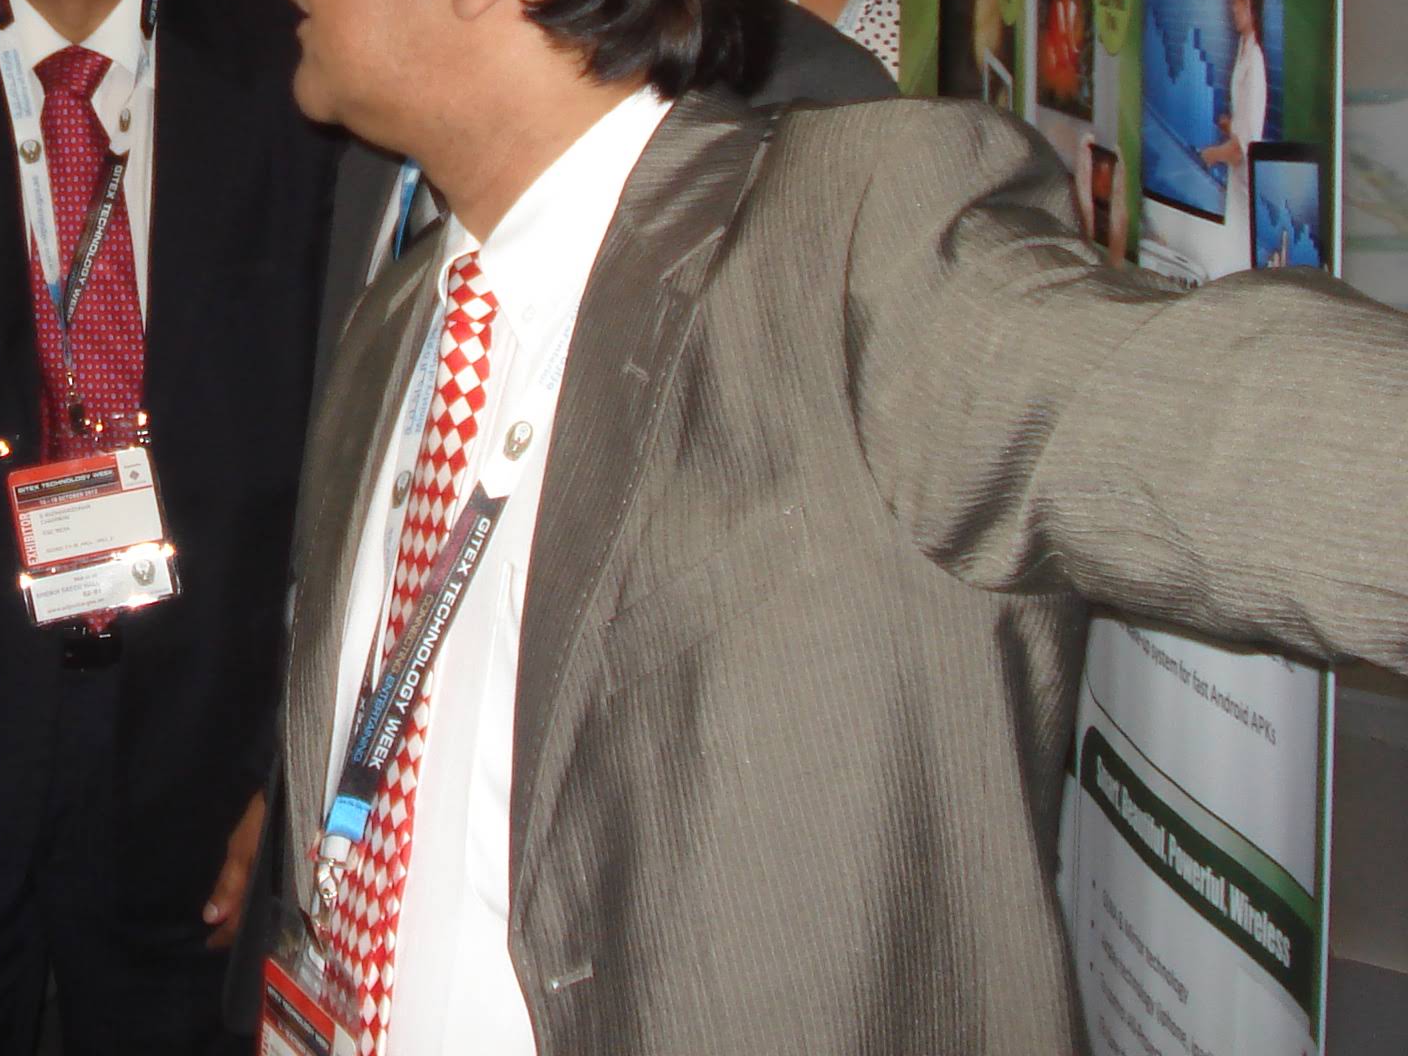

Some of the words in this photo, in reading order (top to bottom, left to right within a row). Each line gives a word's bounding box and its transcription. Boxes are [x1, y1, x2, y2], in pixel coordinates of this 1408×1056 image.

[107, 165, 123, 201] GITEX
[78, 201, 112, 287] TECHNOLOGY
[457, 517, 491, 577] GITEX
[395, 580, 463, 715] TECHNOLOGY
[367, 717, 401, 771] WEEK
[1229, 882, 1291, 969] Wireless
